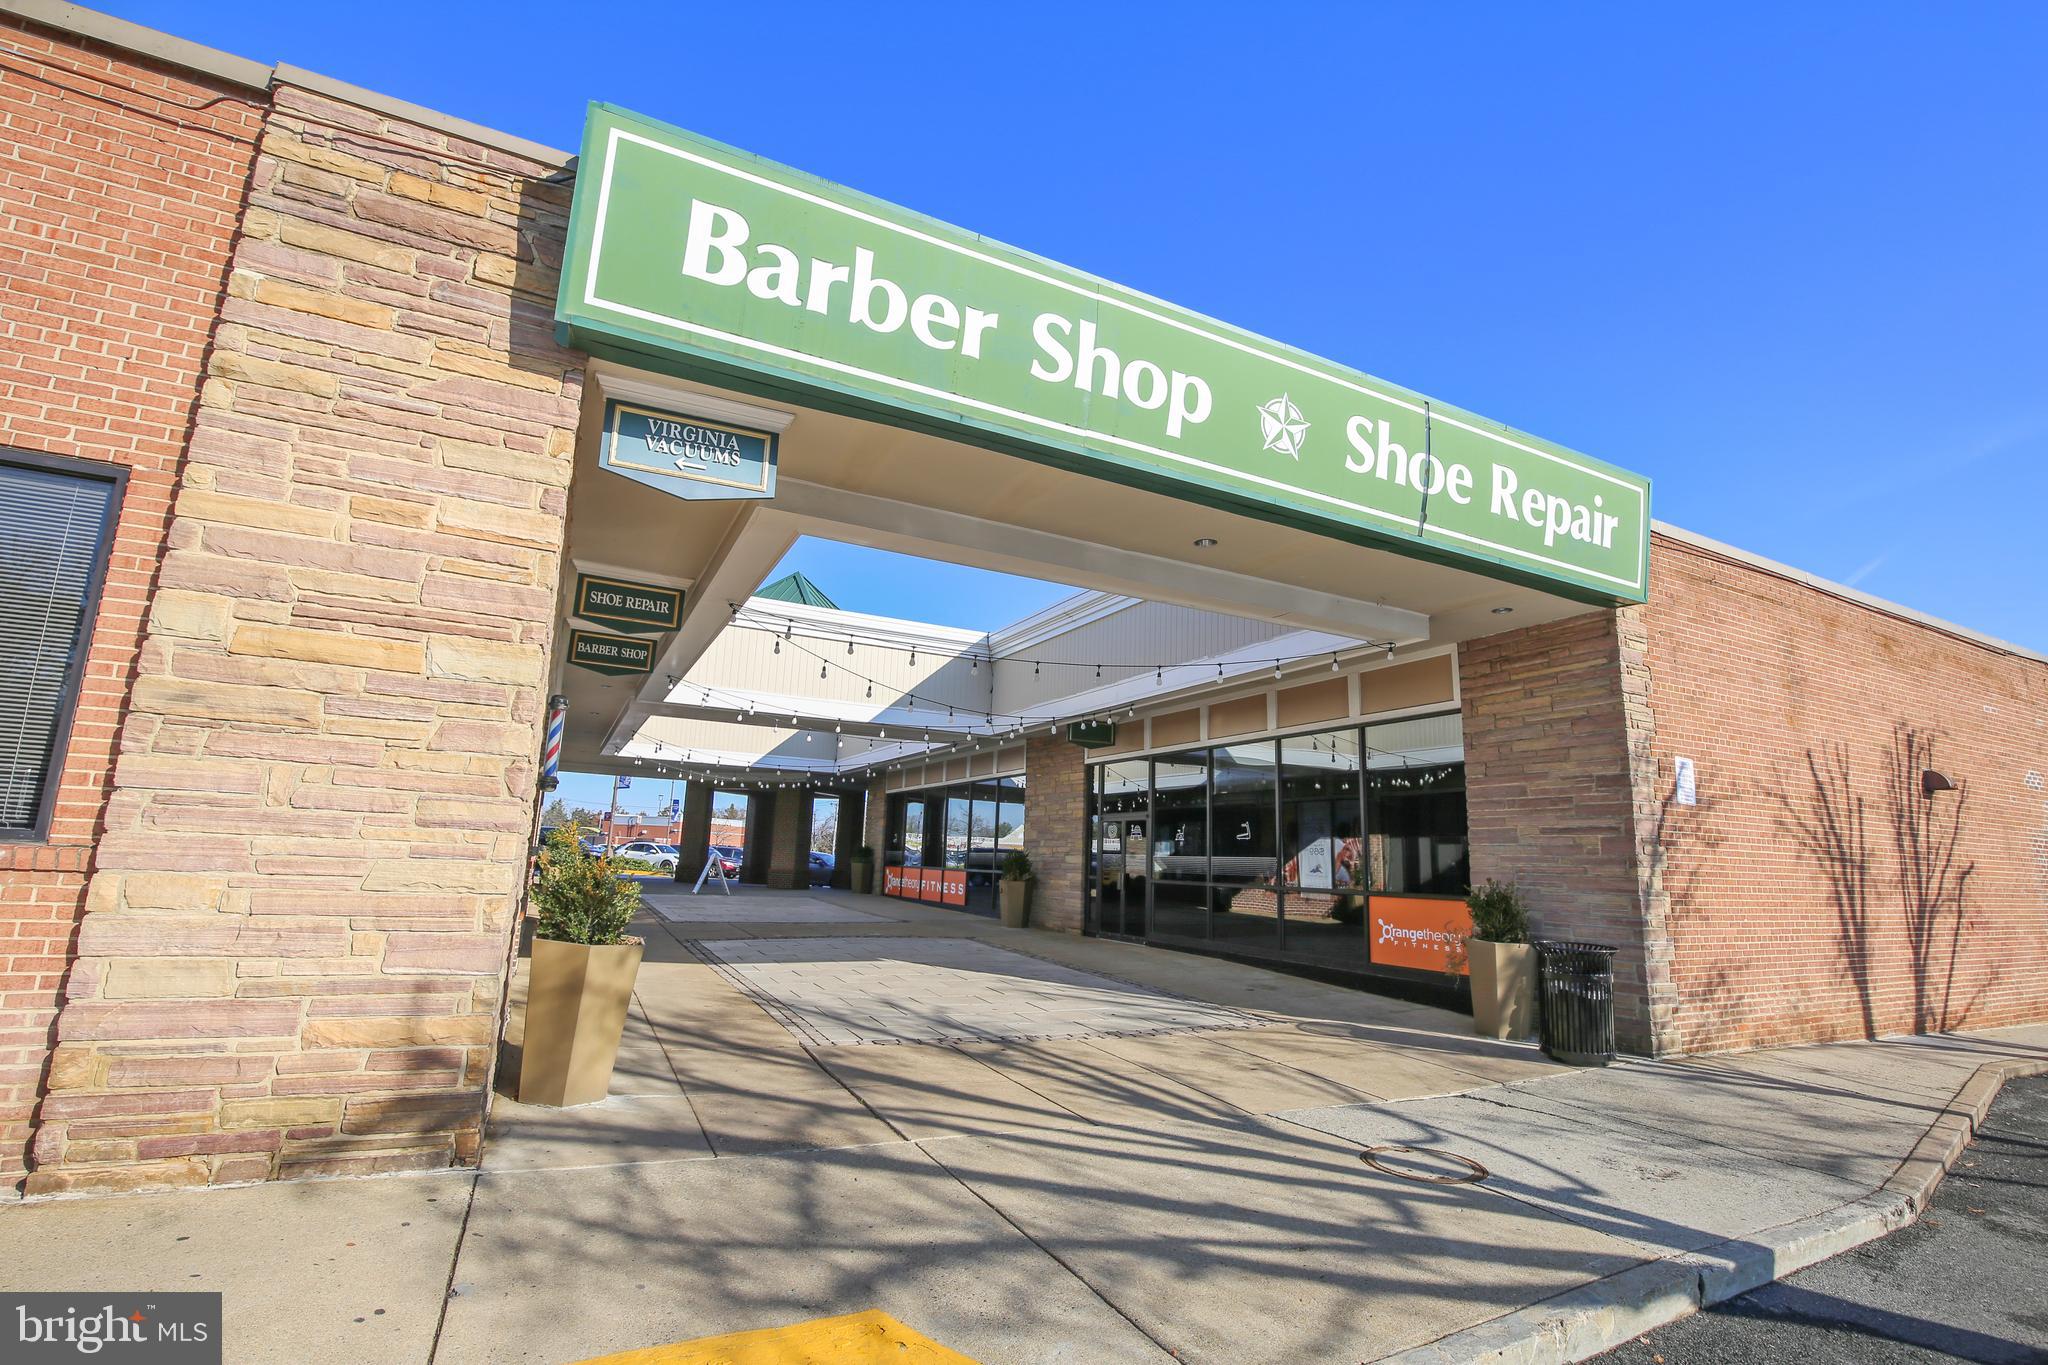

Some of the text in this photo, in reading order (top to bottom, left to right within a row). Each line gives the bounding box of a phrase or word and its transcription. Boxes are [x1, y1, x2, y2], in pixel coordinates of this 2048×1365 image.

[681, 198, 1619, 549] Barber Shop Shoe Repair
[647, 418, 740, 451] VIRGINIA
[645, 434, 741, 467] VACUUMS
[589, 590, 669, 614] SHOE REPAIR
[577, 641, 648, 660] BARBER SHOP
[921, 880, 964, 896] FITNESS
[1394, 940, 1462, 953] FITNESS
